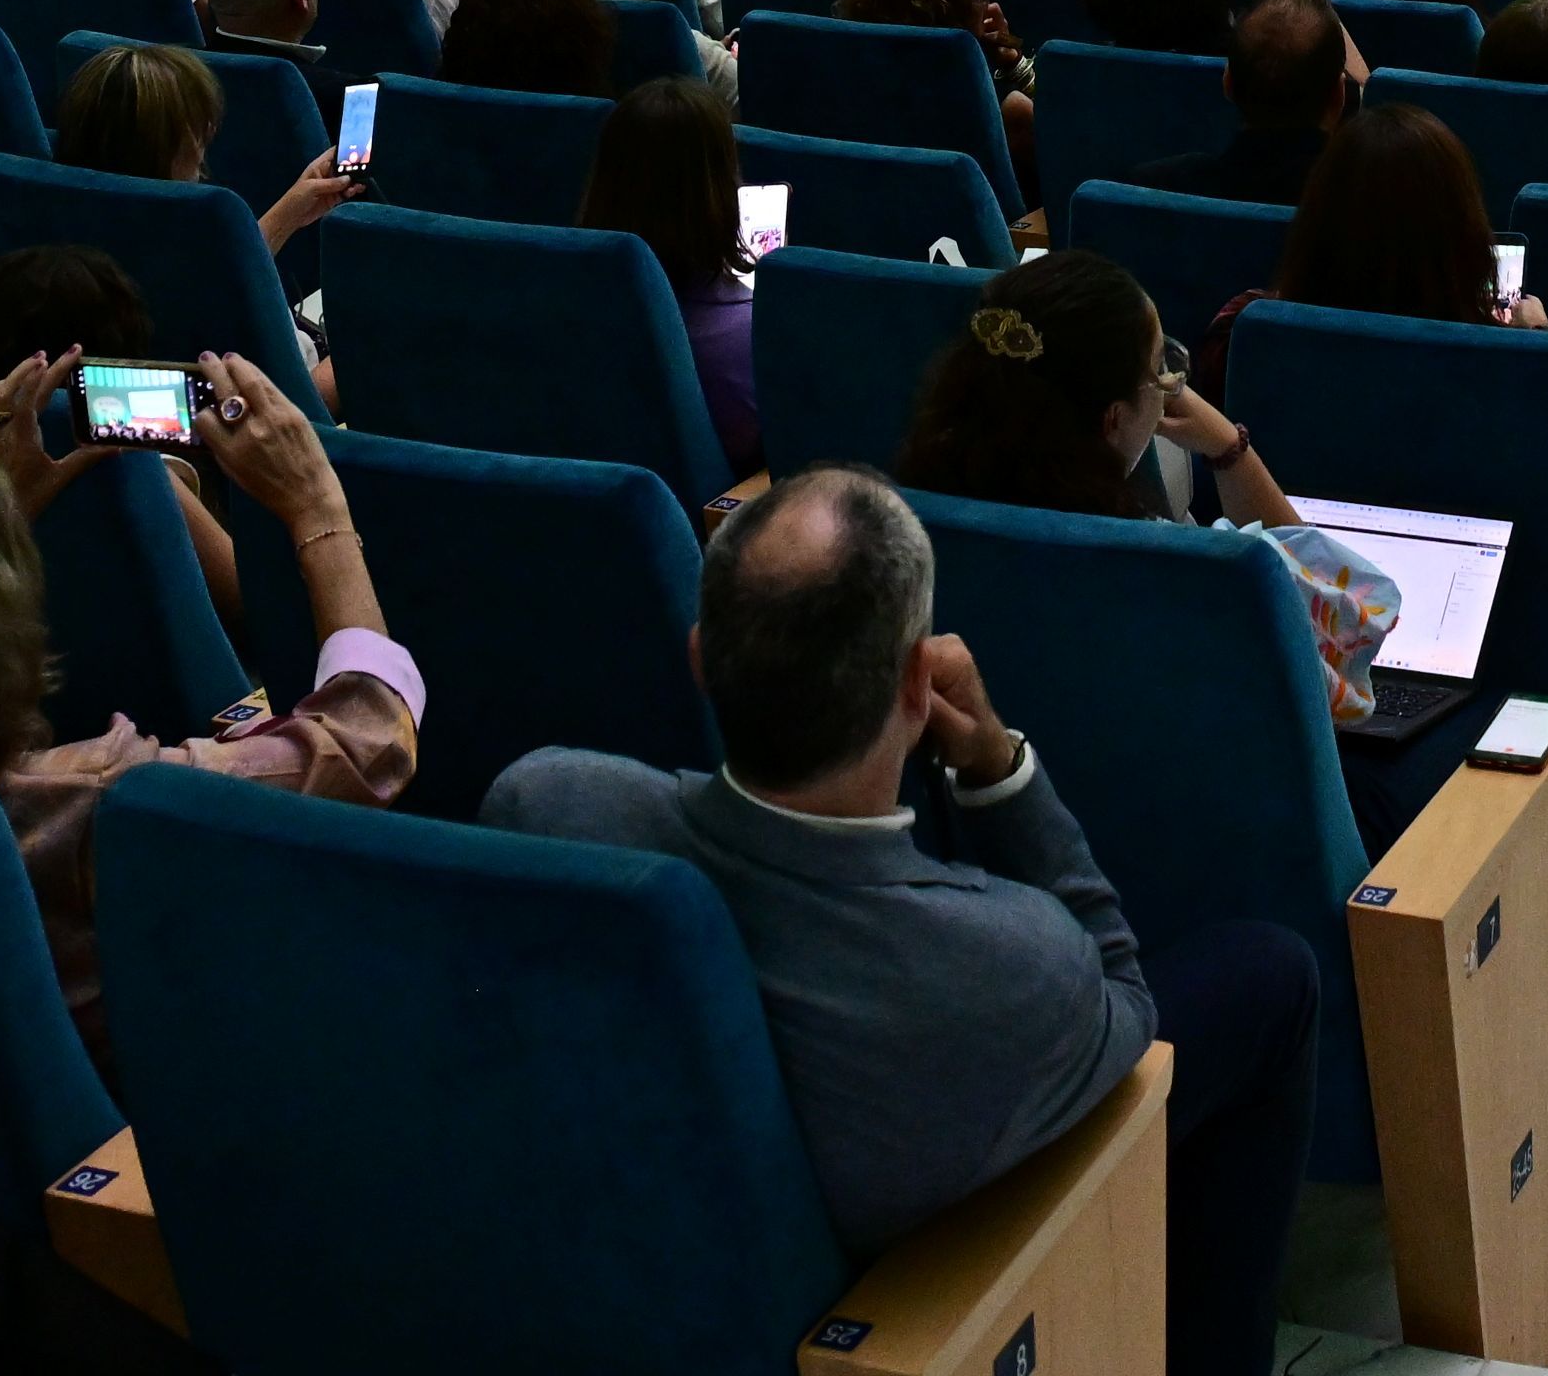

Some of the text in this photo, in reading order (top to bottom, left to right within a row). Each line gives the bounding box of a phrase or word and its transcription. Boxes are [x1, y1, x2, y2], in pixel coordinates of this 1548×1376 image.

[1360, 887, 1390, 903] 25
[67, 1171, 108, 1191] 26
[818, 1323, 860, 1346] 25
